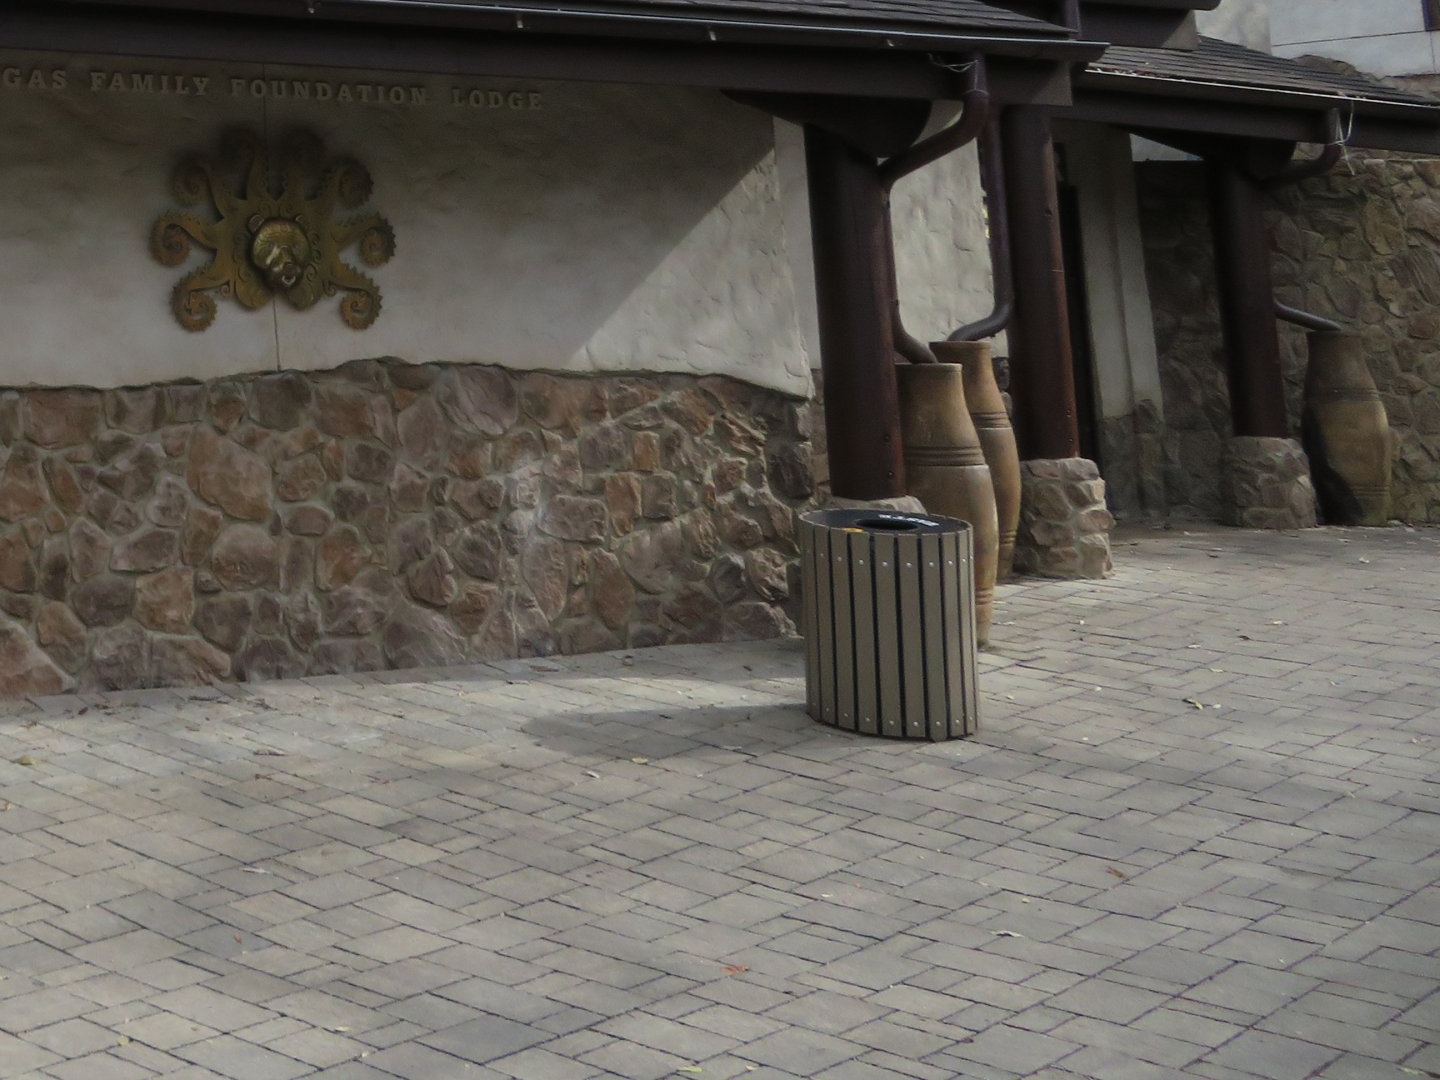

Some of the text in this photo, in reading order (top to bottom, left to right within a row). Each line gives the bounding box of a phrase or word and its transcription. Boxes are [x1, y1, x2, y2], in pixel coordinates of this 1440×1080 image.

[90, 71, 210, 96] FAMILY
[231, 78, 429, 105] FOUNDATION
[452, 88, 543, 111] LODGE
